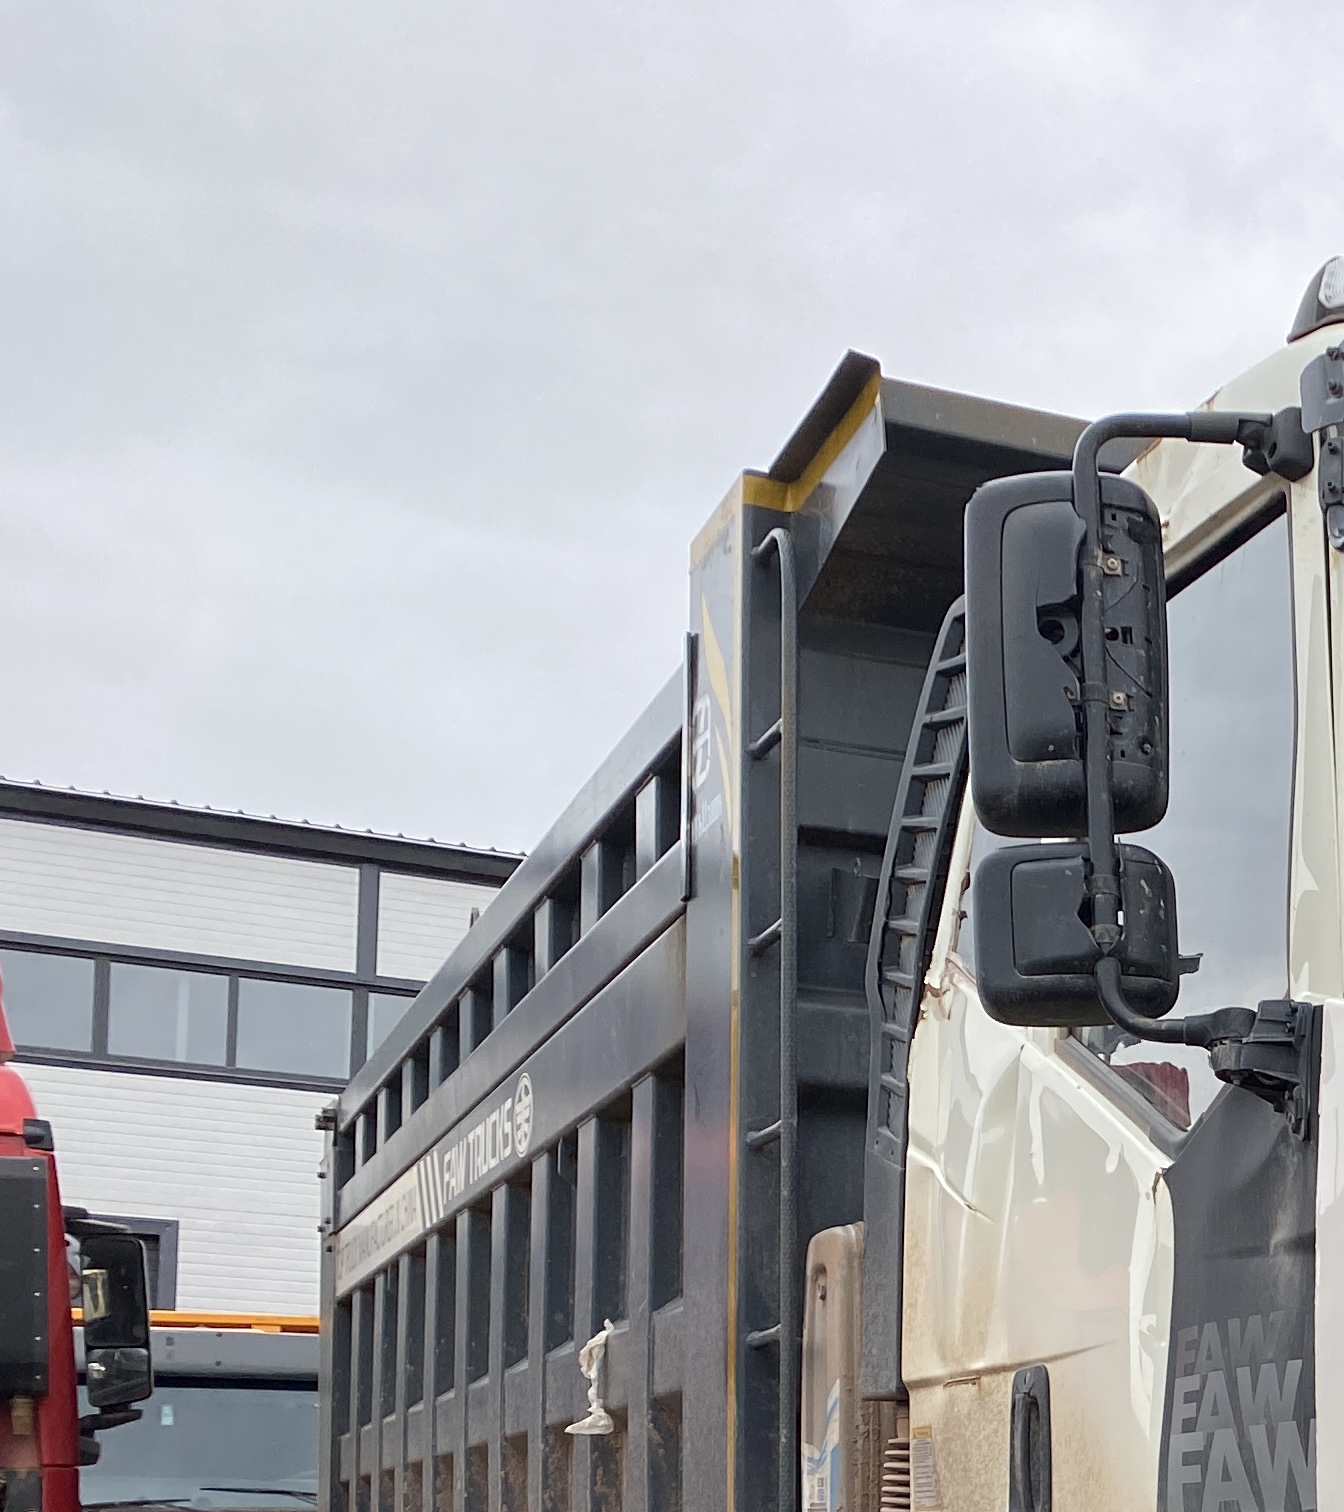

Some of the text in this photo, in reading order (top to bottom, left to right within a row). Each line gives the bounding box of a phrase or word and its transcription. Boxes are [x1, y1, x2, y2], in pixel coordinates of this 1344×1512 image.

[443, 1137, 467, 1205] FAW
[1175, 1310, 1285, 1379] FAW
[1171, 1359, 1303, 1441] FAW
